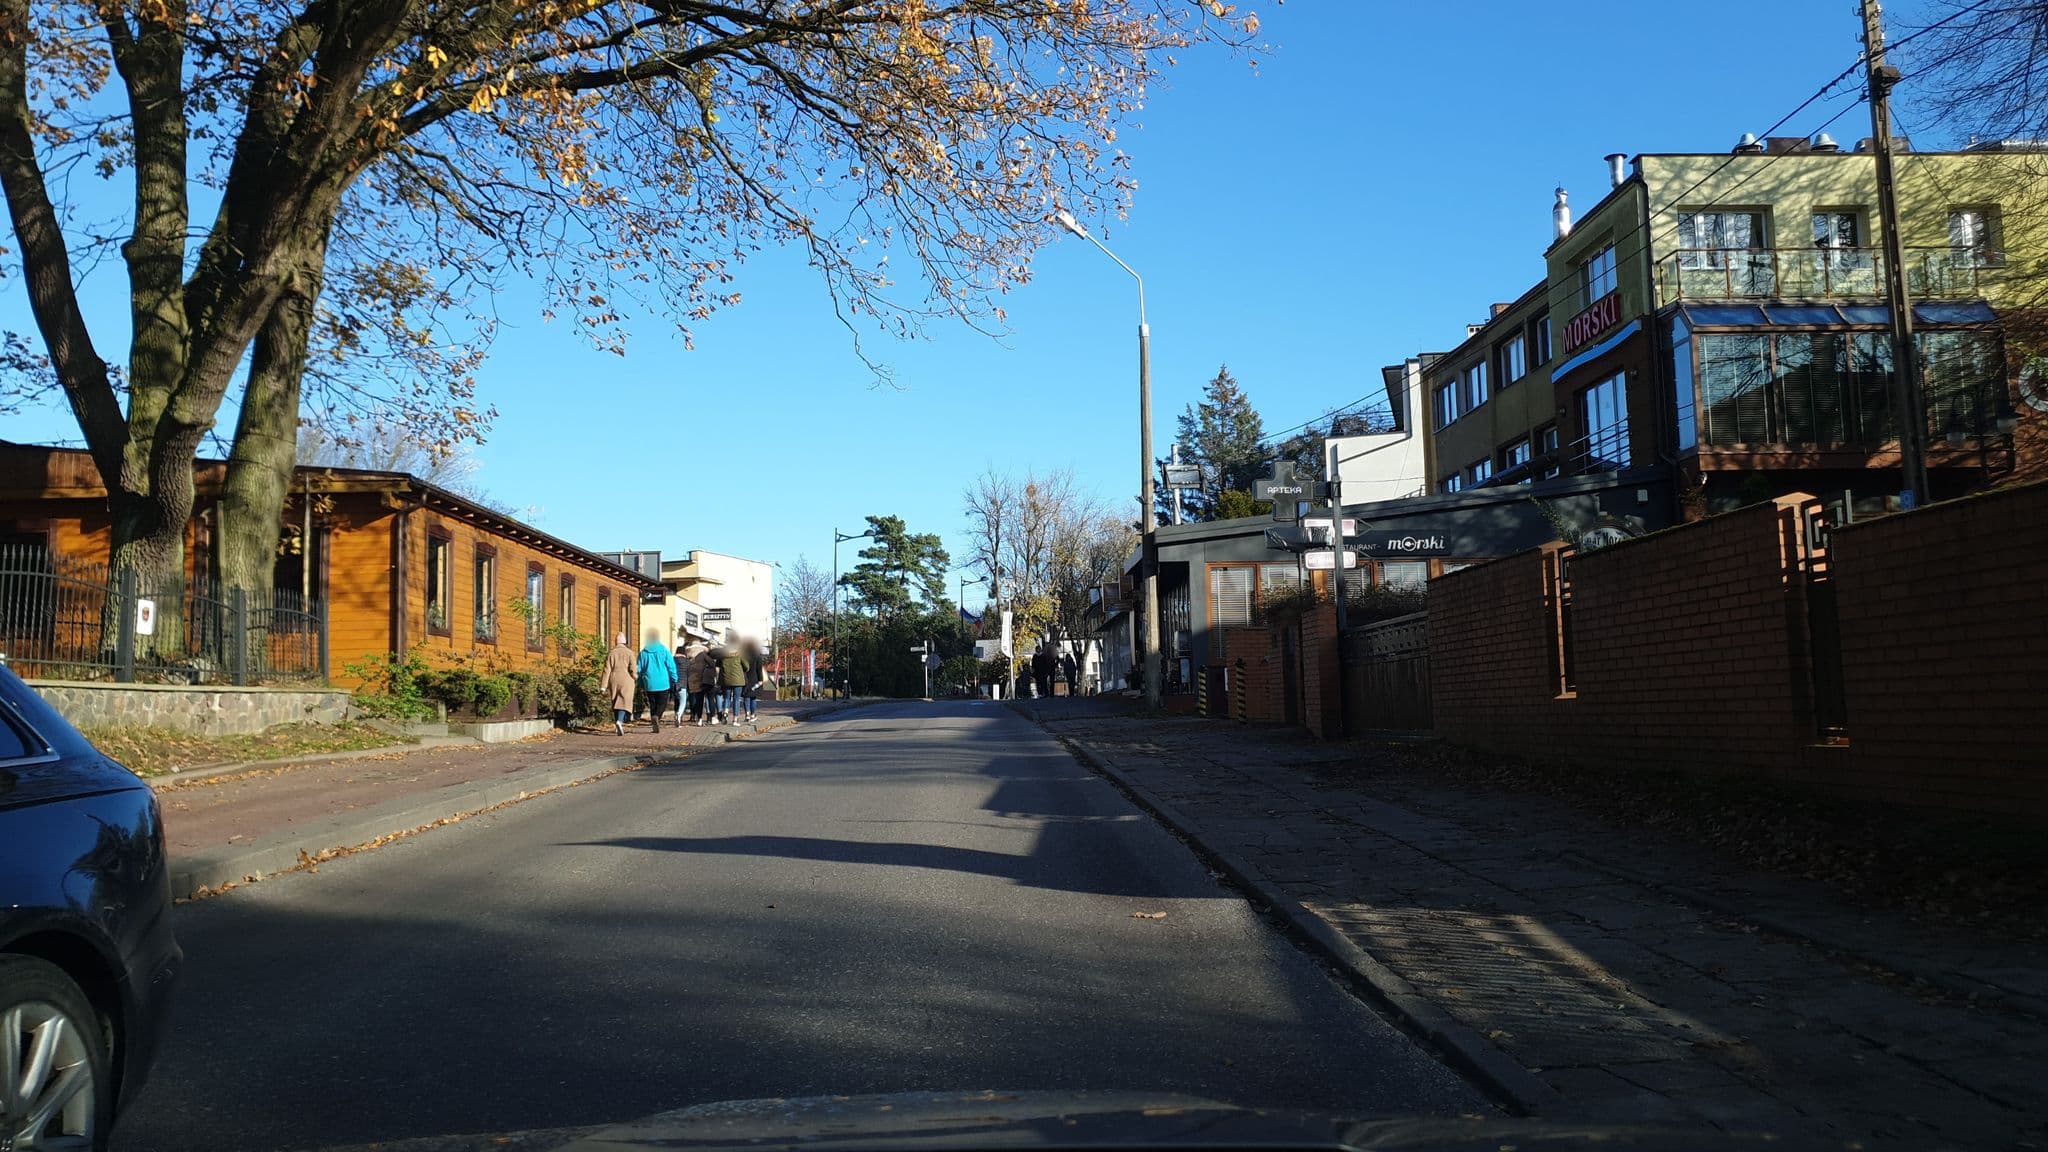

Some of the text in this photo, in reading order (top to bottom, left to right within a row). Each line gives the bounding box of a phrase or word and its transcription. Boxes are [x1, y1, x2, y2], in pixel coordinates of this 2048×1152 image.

[1562, 294, 1617, 354] MORSKI
[1267, 486, 1302, 494] APTEKA
[1333, 543, 1378, 551] STAURANT
[1387, 536, 1445, 551] morski
